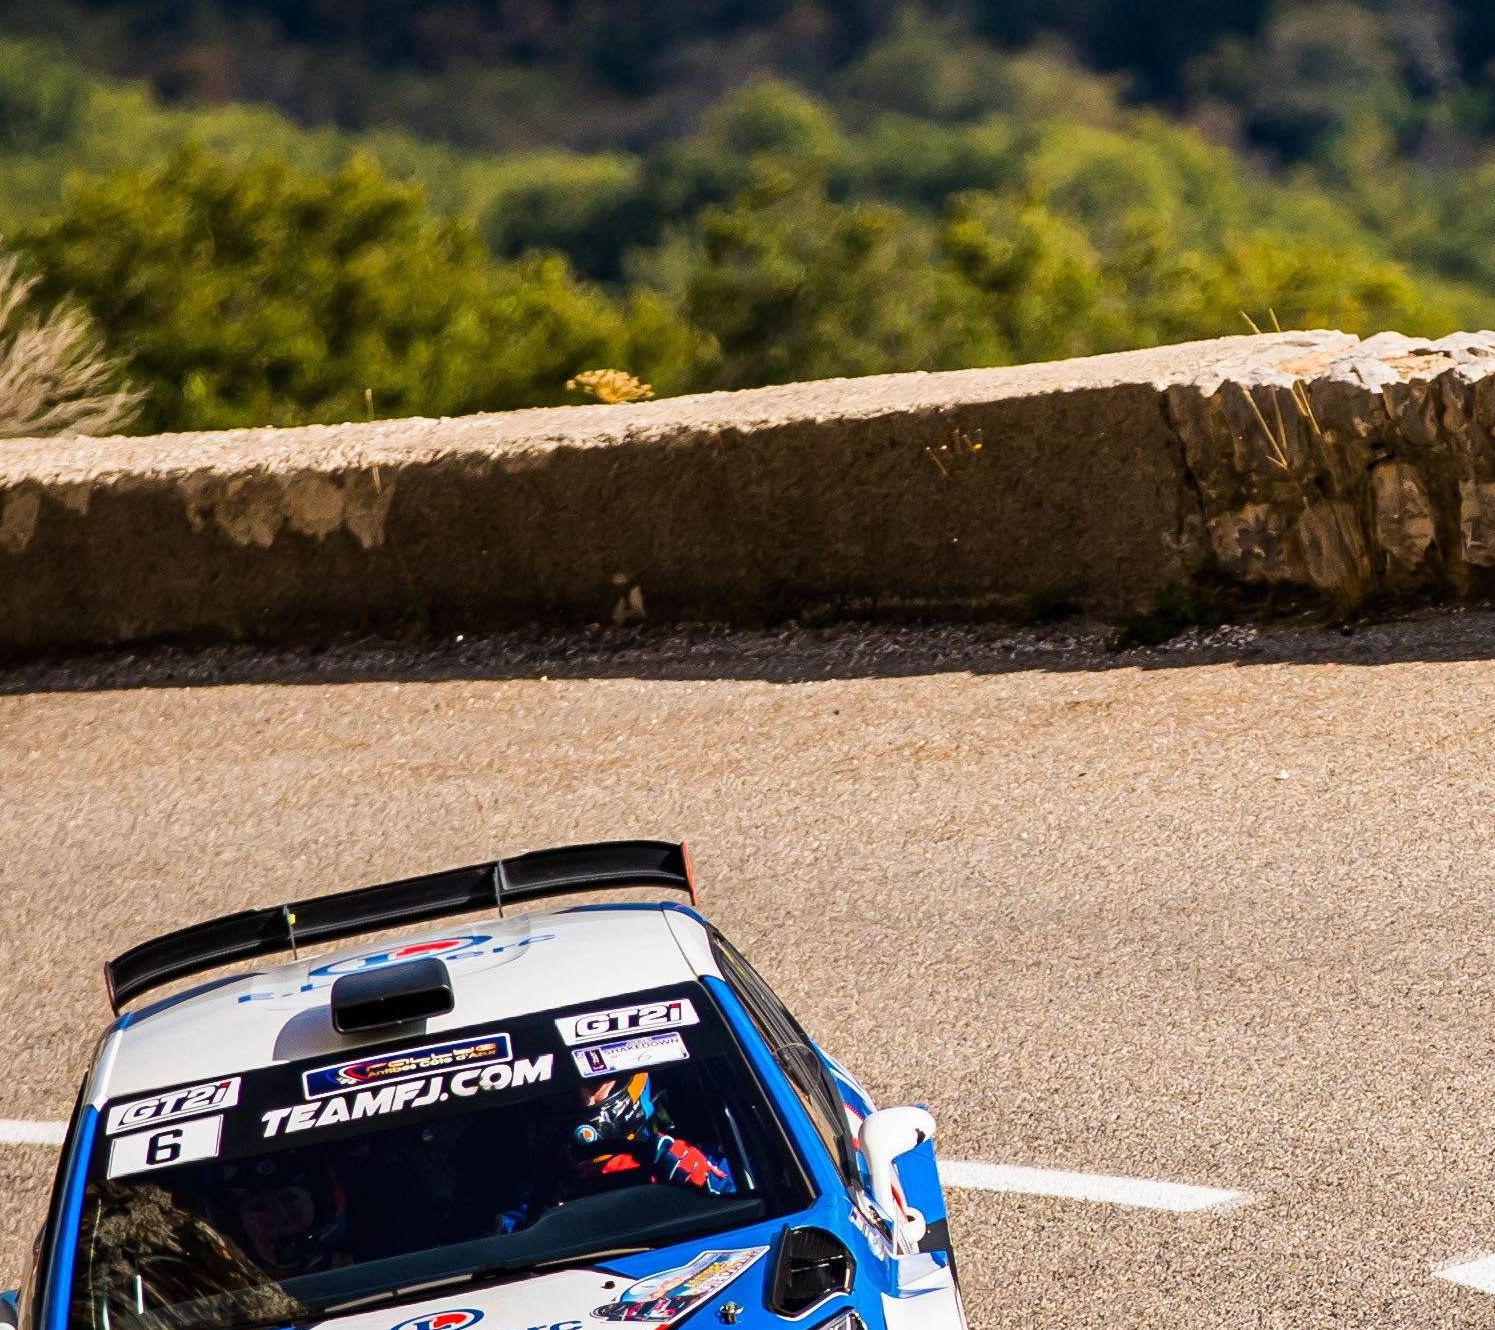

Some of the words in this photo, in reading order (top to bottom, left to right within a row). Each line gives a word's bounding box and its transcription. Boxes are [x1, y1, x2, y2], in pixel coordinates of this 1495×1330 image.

[575, 1003, 682, 1038] GT2i
[604, 1037, 680, 1056] SHAKEDOWN
[118, 1080, 232, 1127] GT2i
[261, 1053, 554, 1138] TEAMFJ.COM
[146, 1128, 184, 1166] 6
